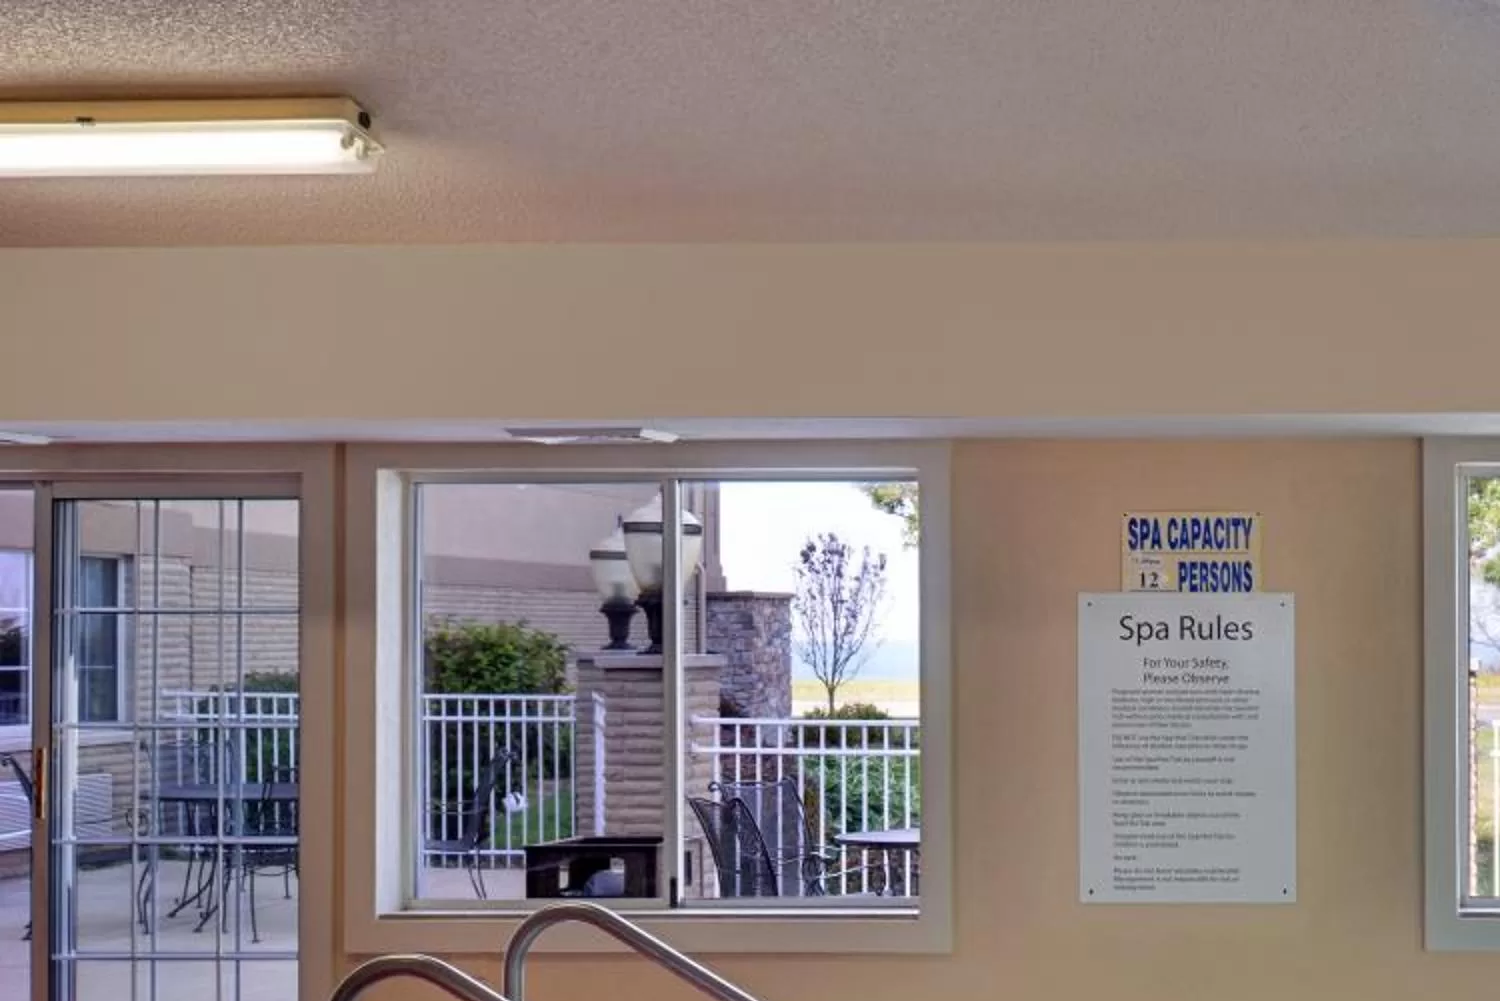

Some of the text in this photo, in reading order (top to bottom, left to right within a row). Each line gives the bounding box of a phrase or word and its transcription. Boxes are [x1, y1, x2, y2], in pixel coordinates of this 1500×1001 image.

[1128, 517, 1253, 551] SPA CAPACITY
[1178, 561, 1253, 592] PERSONS
[1119, 613, 1254, 646] Spa Rules
[1143, 657, 1161, 669] For
[1163, 657, 1189, 669] Your
[1143, 672, 1231, 685] Please Observe
